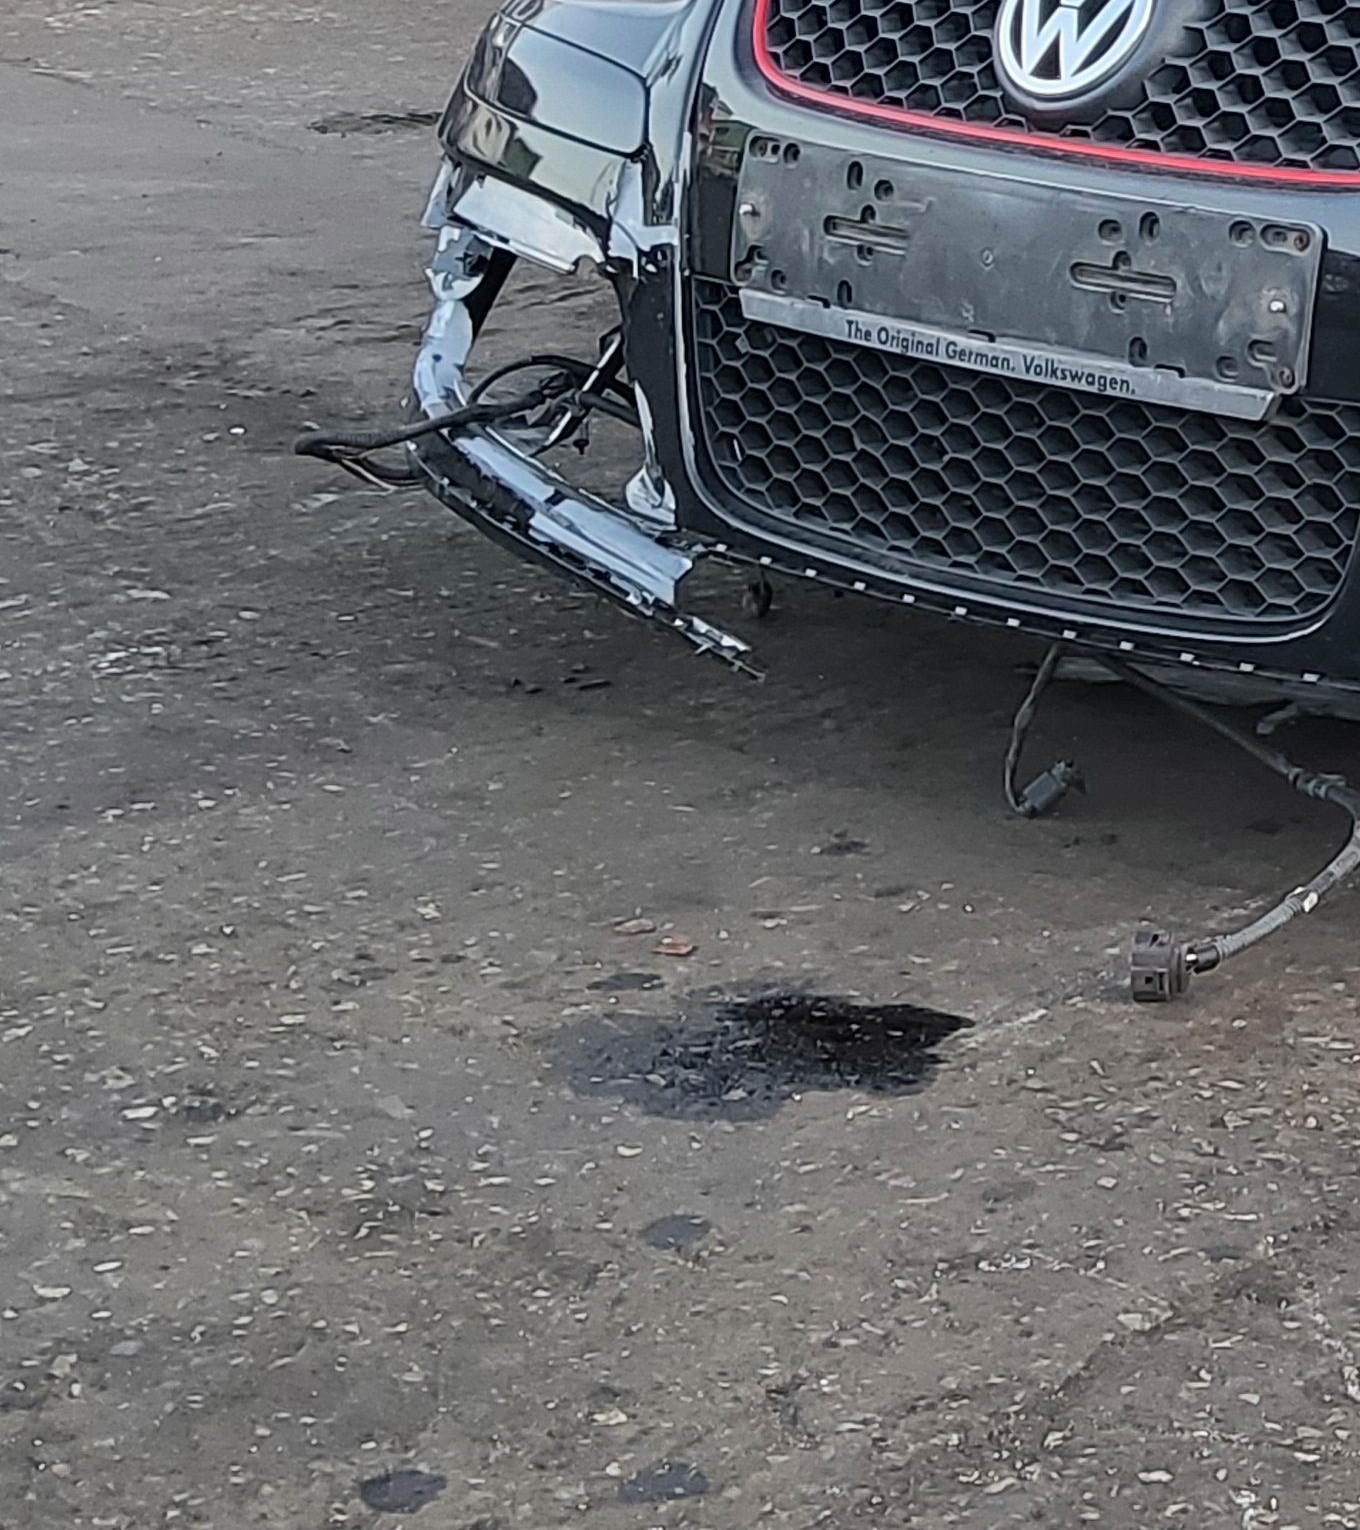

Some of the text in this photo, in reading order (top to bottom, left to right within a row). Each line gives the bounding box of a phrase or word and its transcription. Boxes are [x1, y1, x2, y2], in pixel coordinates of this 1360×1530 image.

[845, 320, 872, 343] The
[876, 326, 941, 357] Original
[1022, 354, 1137, 395] Volkswagen.
